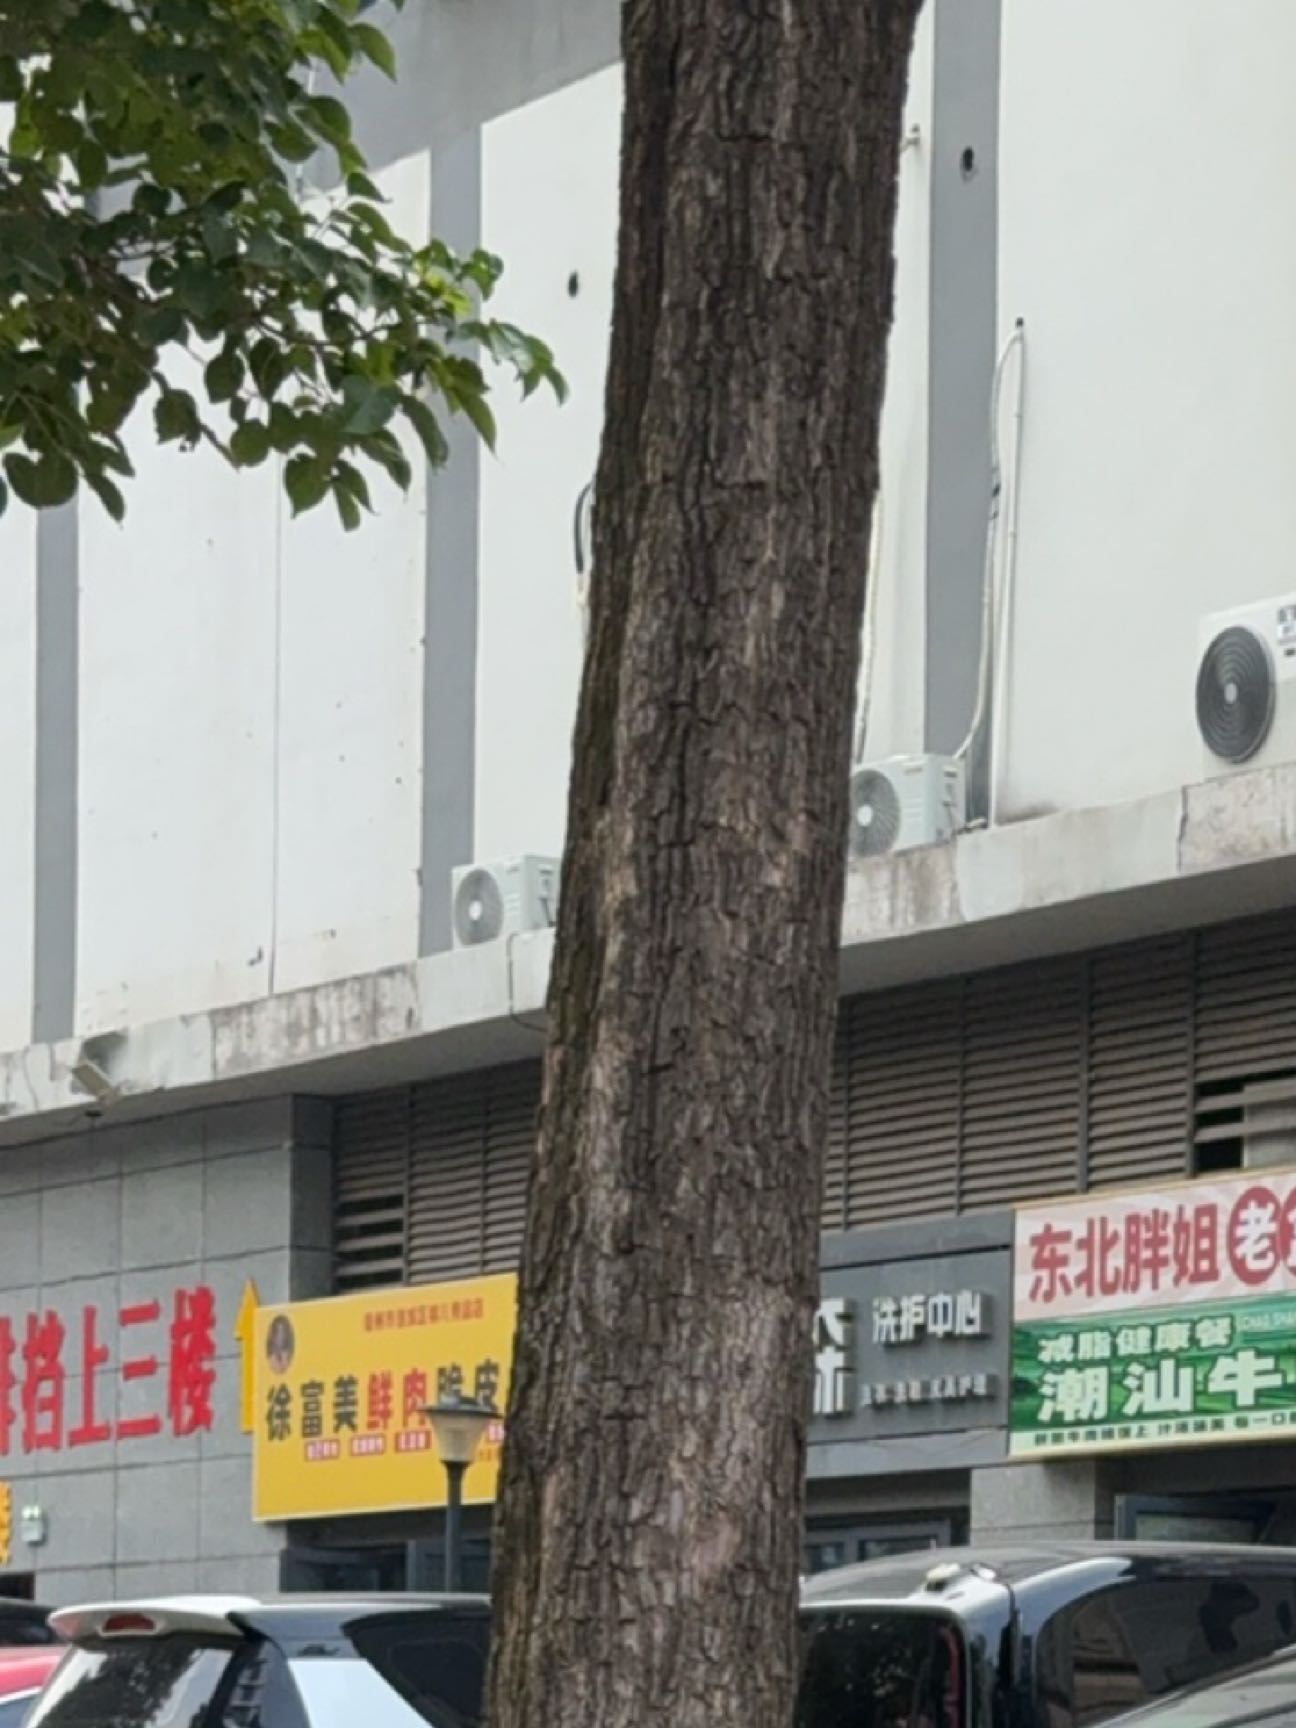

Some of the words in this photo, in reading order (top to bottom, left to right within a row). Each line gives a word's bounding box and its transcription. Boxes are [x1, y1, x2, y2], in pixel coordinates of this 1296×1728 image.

[872, 1289, 982, 1344] 洗护中心
[1037, 1315, 1232, 1363] 减脂健康餐
